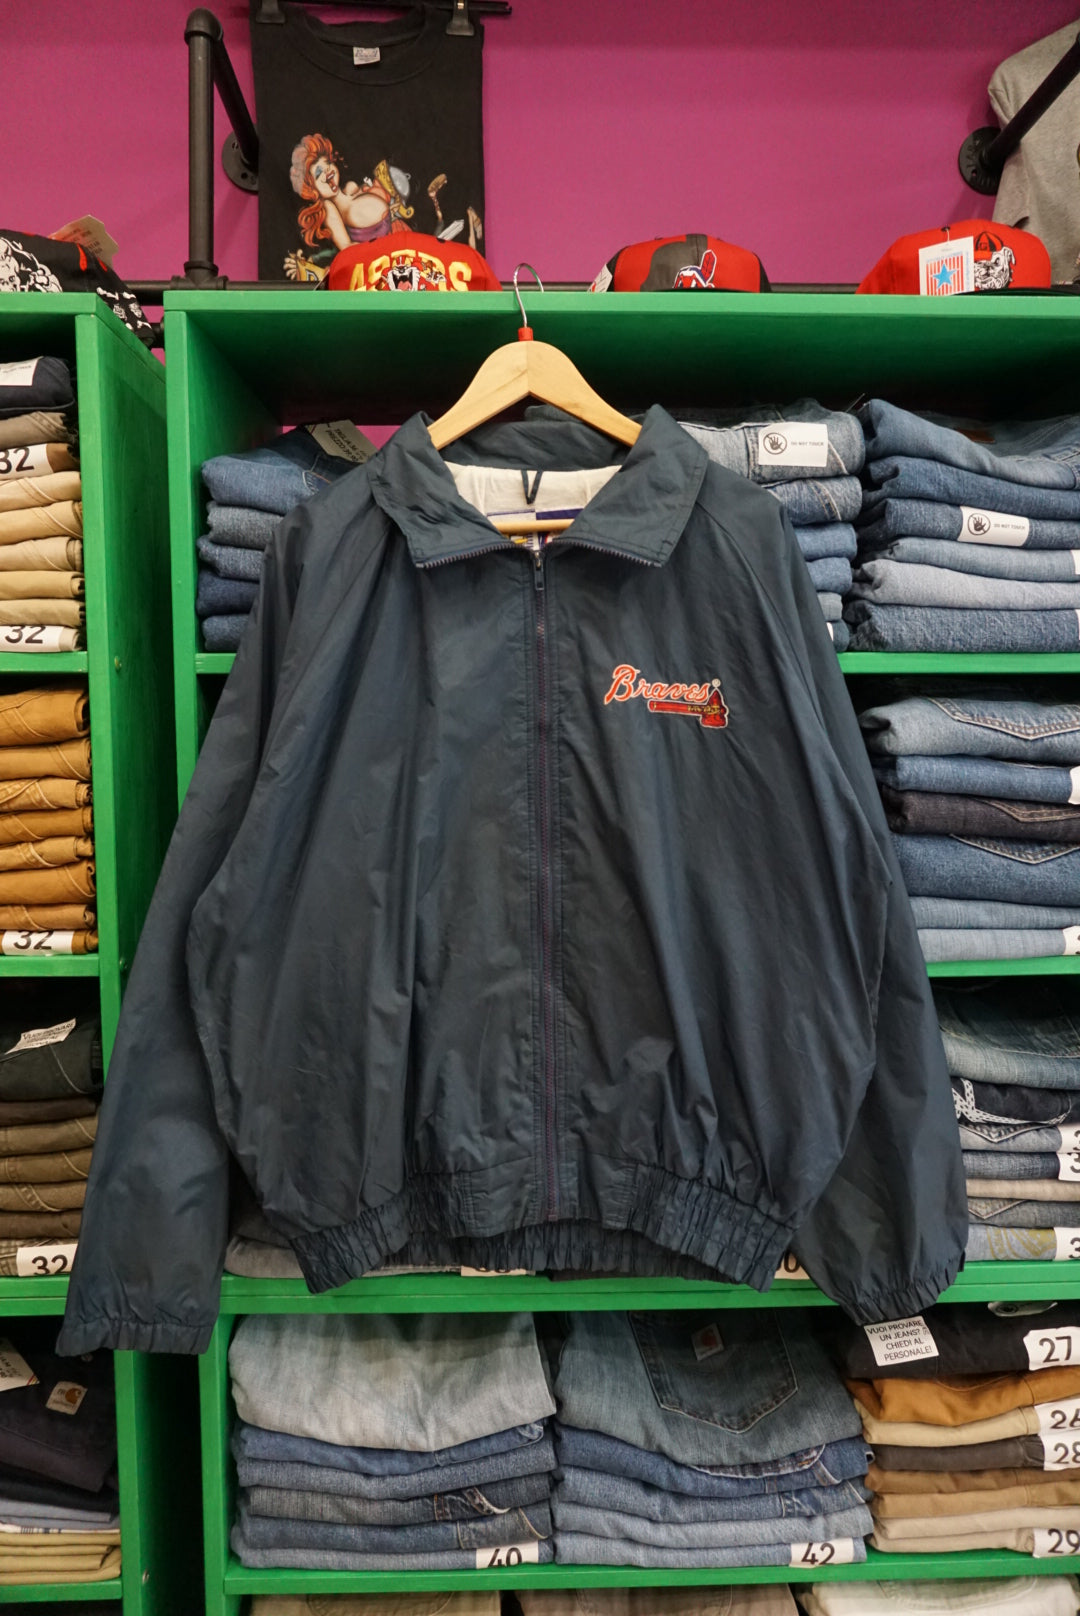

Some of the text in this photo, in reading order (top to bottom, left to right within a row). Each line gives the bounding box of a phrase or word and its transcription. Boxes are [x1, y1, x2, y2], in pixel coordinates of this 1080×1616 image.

[0, 447, 35, 474] 32
[5, 624, 46, 644] 32
[603, 664, 711, 705] Braves
[13, 930, 54, 950] 32
[32, 1254, 70, 1275] 32
[867, 1320, 923, 1335] VUOI PROVARE
[893, 1328, 920, 1340] JEANS?
[883, 1346, 933, 1361] PERSONALE!
[885, 1339, 912, 1350] CHIEDI
[1039, 1335, 1072, 1363] 27
[1048, 1528, 1080, 1554] 29
[488, 1547, 522, 1567] 40
[801, 1542, 835, 1566] 42
